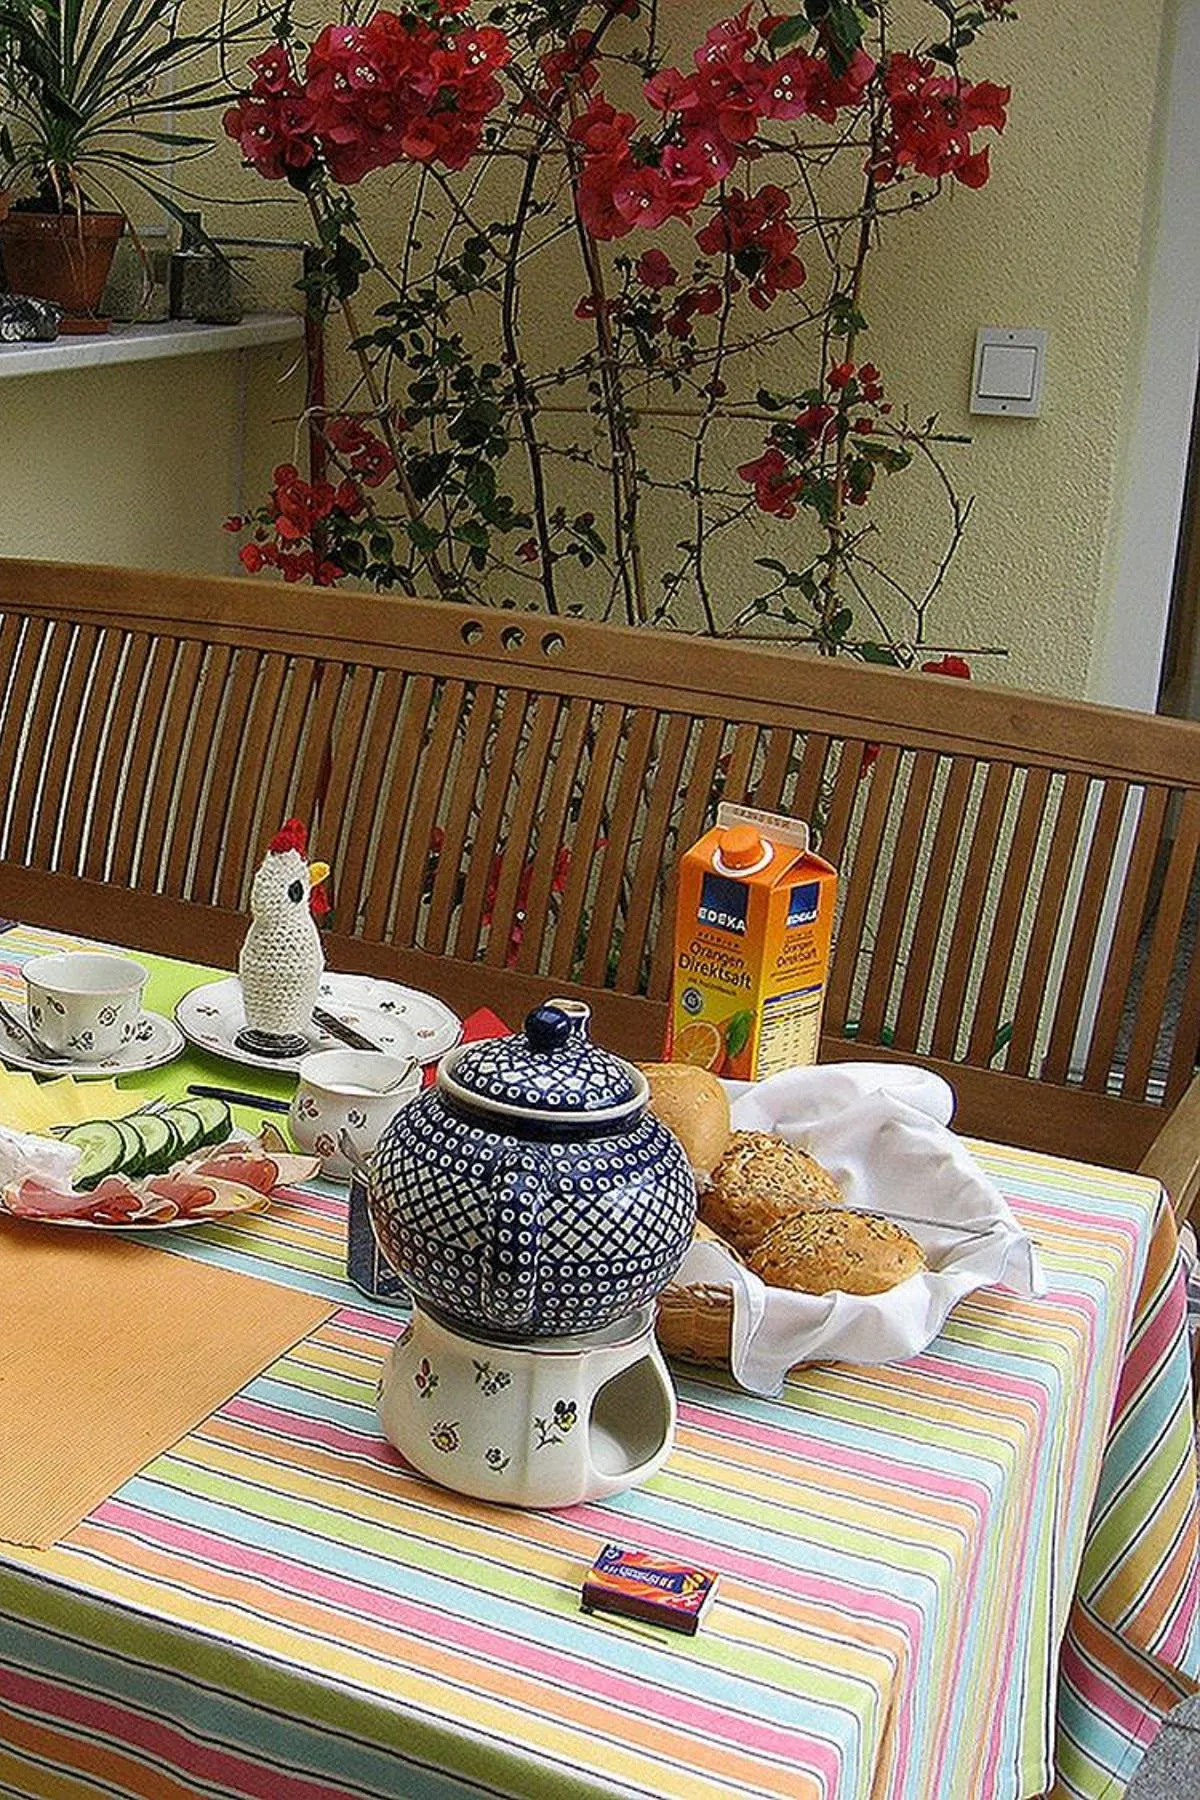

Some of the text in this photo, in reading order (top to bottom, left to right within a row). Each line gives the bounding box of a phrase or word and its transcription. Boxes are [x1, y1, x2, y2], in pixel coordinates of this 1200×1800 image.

[697, 907, 746, 931] EDEKA
[690, 941, 744, 968] Orangen
[678, 952, 751, 989] Direktsaft
